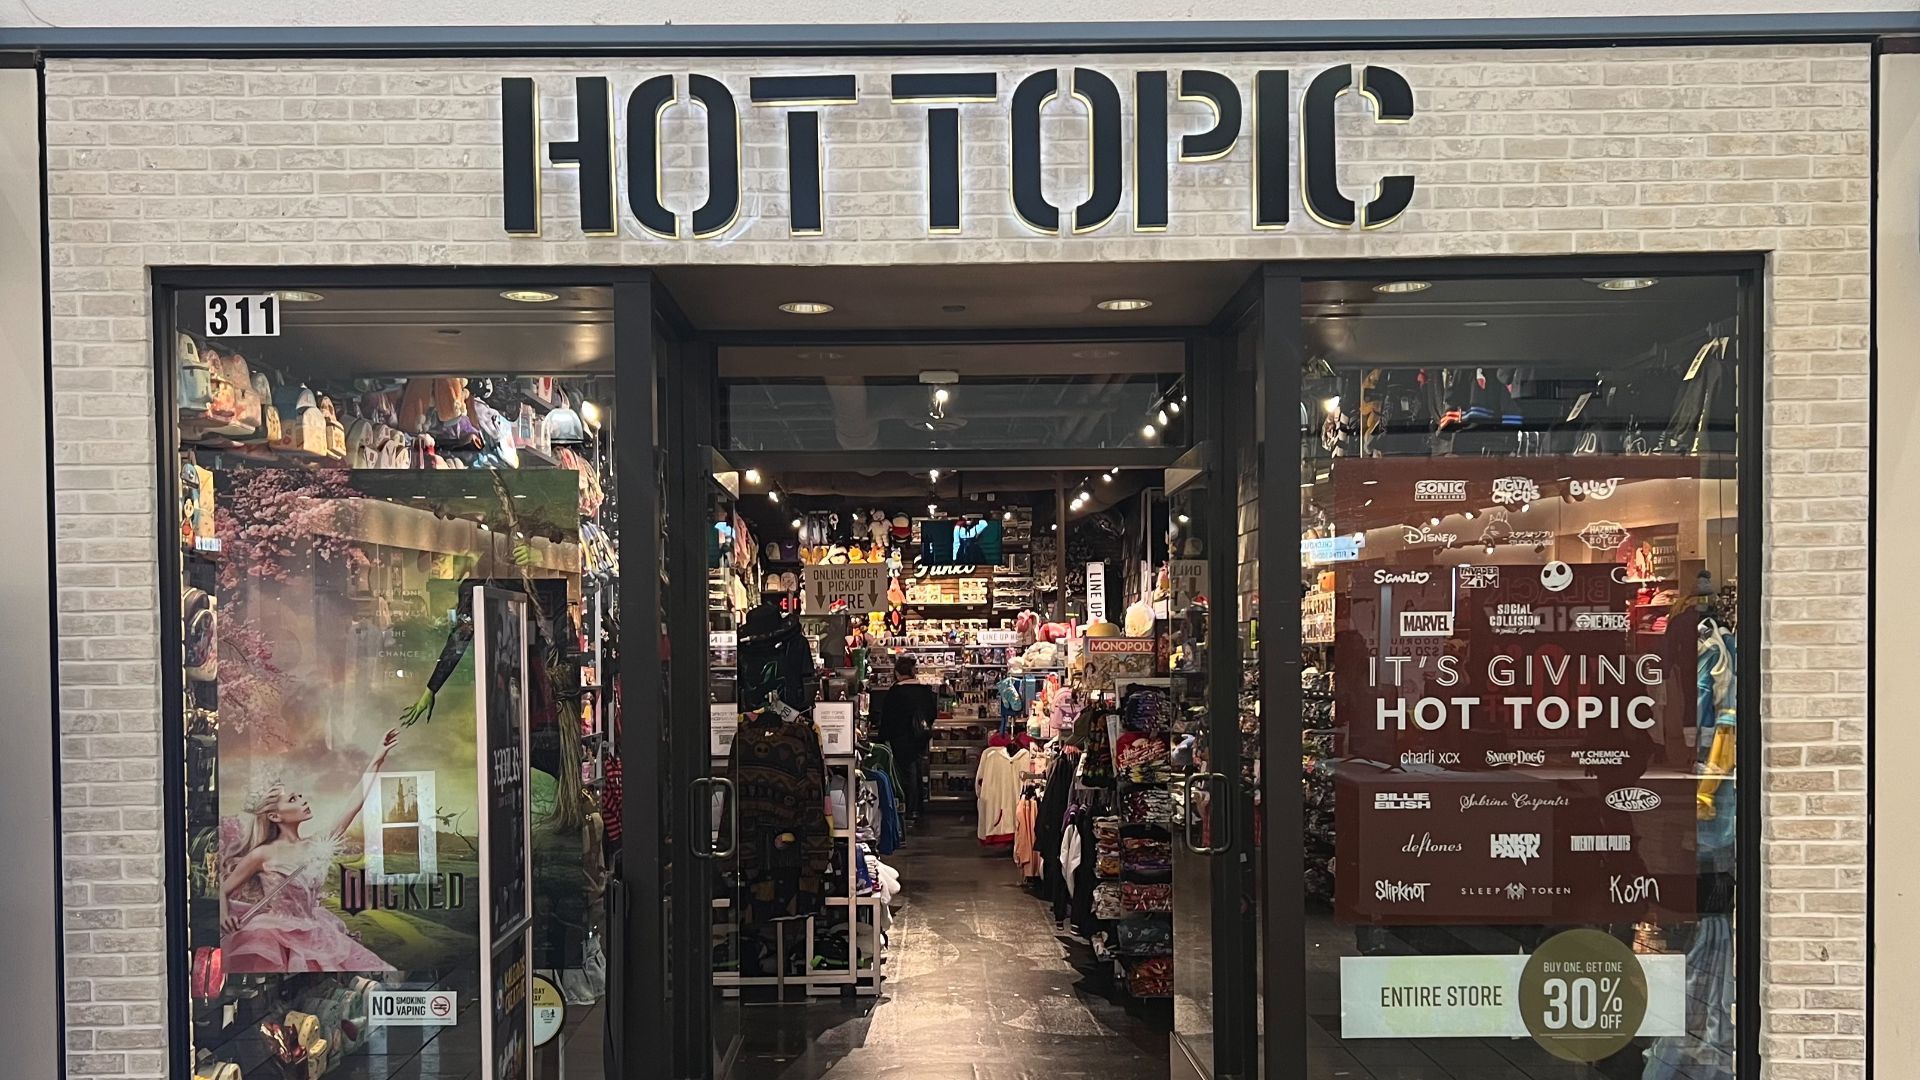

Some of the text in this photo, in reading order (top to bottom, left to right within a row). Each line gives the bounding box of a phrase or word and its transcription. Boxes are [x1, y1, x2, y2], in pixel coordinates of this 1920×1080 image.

[501, 63, 1415, 239] HOT TOPIC
[208, 296, 276, 336] 311
[1417, 482, 1463, 493] SONIC
[1492, 479, 1539, 491] DIGITAL
[1492, 490, 1540, 504] CIRCUS
[813, 568, 878, 580] ONLINE ORDER
[829, 580, 864, 592] PICKUP
[1090, 572, 1103, 618] LINE UP
[1497, 604, 1532, 615] SOCIAL
[1403, 615, 1450, 631] MARVEL
[1489, 615, 1541, 626] COLLISION
[982, 633, 998, 641] LINE
[1000, 633, 1009, 641] UP
[1091, 641, 1153, 651] MONOPOLY
[1369, 655, 1459, 687] IT'S
[1487, 654, 1663, 687] GIVING
[1376, 696, 1656, 731] HOT TOPIC
[1400, 750, 1461, 764] charli xcx
[1486, 750, 1546, 764] SNOOP DOGG
[1375, 793, 1430, 801] BILLIE
[1460, 792, 1569, 812] Sabrina Carpenter
[1608, 790, 1651, 804] OLIVIA
[1614, 796, 1659, 809] RODRIGO
[1374, 801, 1431, 809] EILISH
[1401, 832, 1462, 857] deftones
[1491, 834, 1541, 845] LINKIN
[1490, 843, 1540, 865] PARK
[339, 863, 464, 916] WICKED
[1461, 887, 1571, 895] SLEEP TOKEN
[1543, 962, 1623, 974] BUY ONE, GET ONE
[1380, 985, 1503, 1008] ENTIRE STORE
[1543, 977, 1623, 1030] 30%
[372, 996, 426, 1016] NO SMOKING
[396, 1006, 426, 1016] VAPING
[1600, 1014, 1623, 1030] OFF
